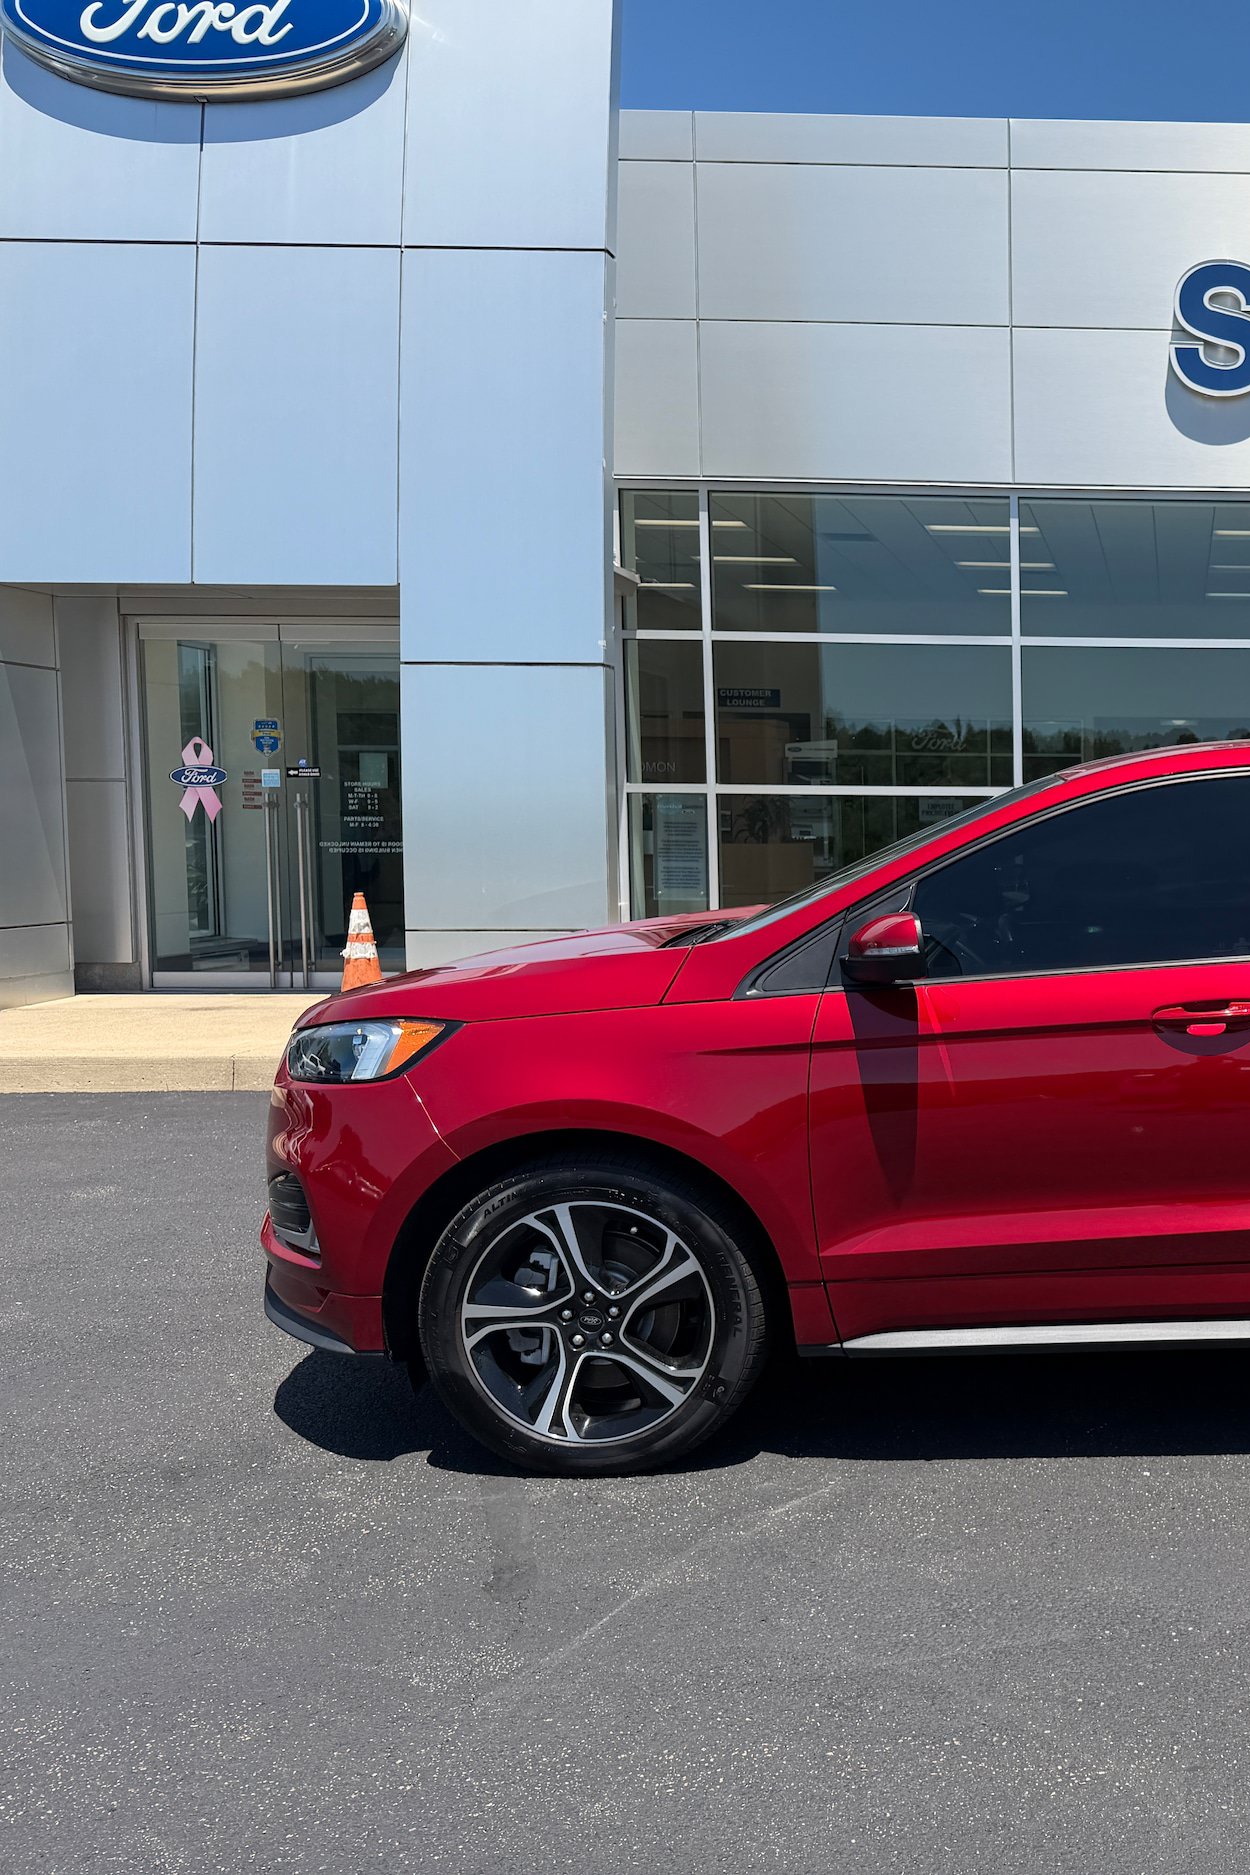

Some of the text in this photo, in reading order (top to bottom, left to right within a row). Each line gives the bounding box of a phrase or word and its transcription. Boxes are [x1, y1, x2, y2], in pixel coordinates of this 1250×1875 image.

[720, 689, 772, 697] CUSTOMER
[912, 727, 967, 751] Ford
[181, 768, 217, 783] Ford
